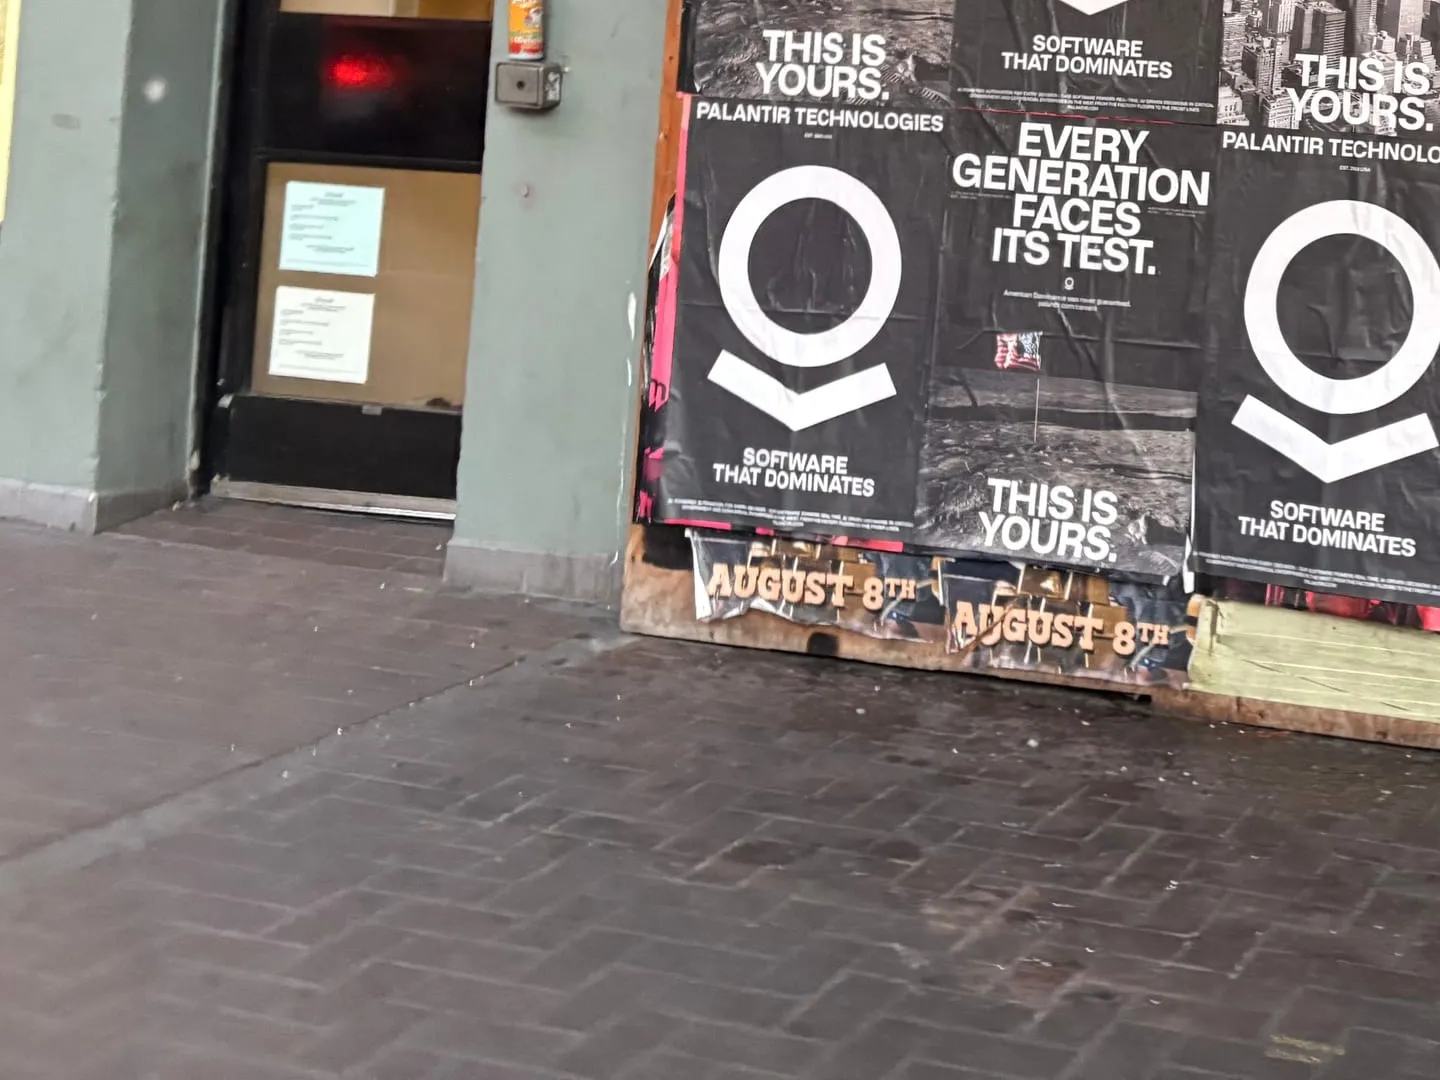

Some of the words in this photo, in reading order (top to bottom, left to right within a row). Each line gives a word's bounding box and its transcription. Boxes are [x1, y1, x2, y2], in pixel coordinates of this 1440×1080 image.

[763, 30, 843, 64] THIS
[852, 34, 886, 66] IS
[1002, 52, 1052, 71] THAT
[1056, 55, 1172, 78] DOMINATES
[1033, 35, 1143, 57] SOFTWARE
[756, 62, 889, 100] YOURS.
[1295, 54, 1385, 92] THIS
[1393, 58, 1430, 94] IS
[697, 102, 790, 124] PALANTIR
[795, 108, 943, 132] TECHNOLOGIES
[1285, 90, 1434, 131] YOURS.
[1018, 122, 1149, 164] EVERY
[1223, 131, 1323, 155] PALANTIR
[952, 153, 1210, 206] GENERATION
[1013, 194, 1140, 236] FACES
[993, 228, 1049, 265] ITS
[1057, 233, 1155, 274] TEST.
[713, 463, 761, 485] THAT
[765, 469, 874, 497] DOMINATES
[743, 448, 848, 474] SOFTWARE
[988, 478, 1074, 520] THIS
[1082, 489, 1120, 525] IS
[1271, 501, 1385, 532] SOFTWARE
[979, 512, 1117, 563] YOURS.
[1238, 516, 1289, 540] THAT
[1293, 524, 1415, 556] DOMINATES
[708, 563, 855, 607] AUGUST
[862, 579, 916, 610] 8TH
[954, 601, 1103, 650] AUGUST
[1113, 621, 1170, 656] 8TH
